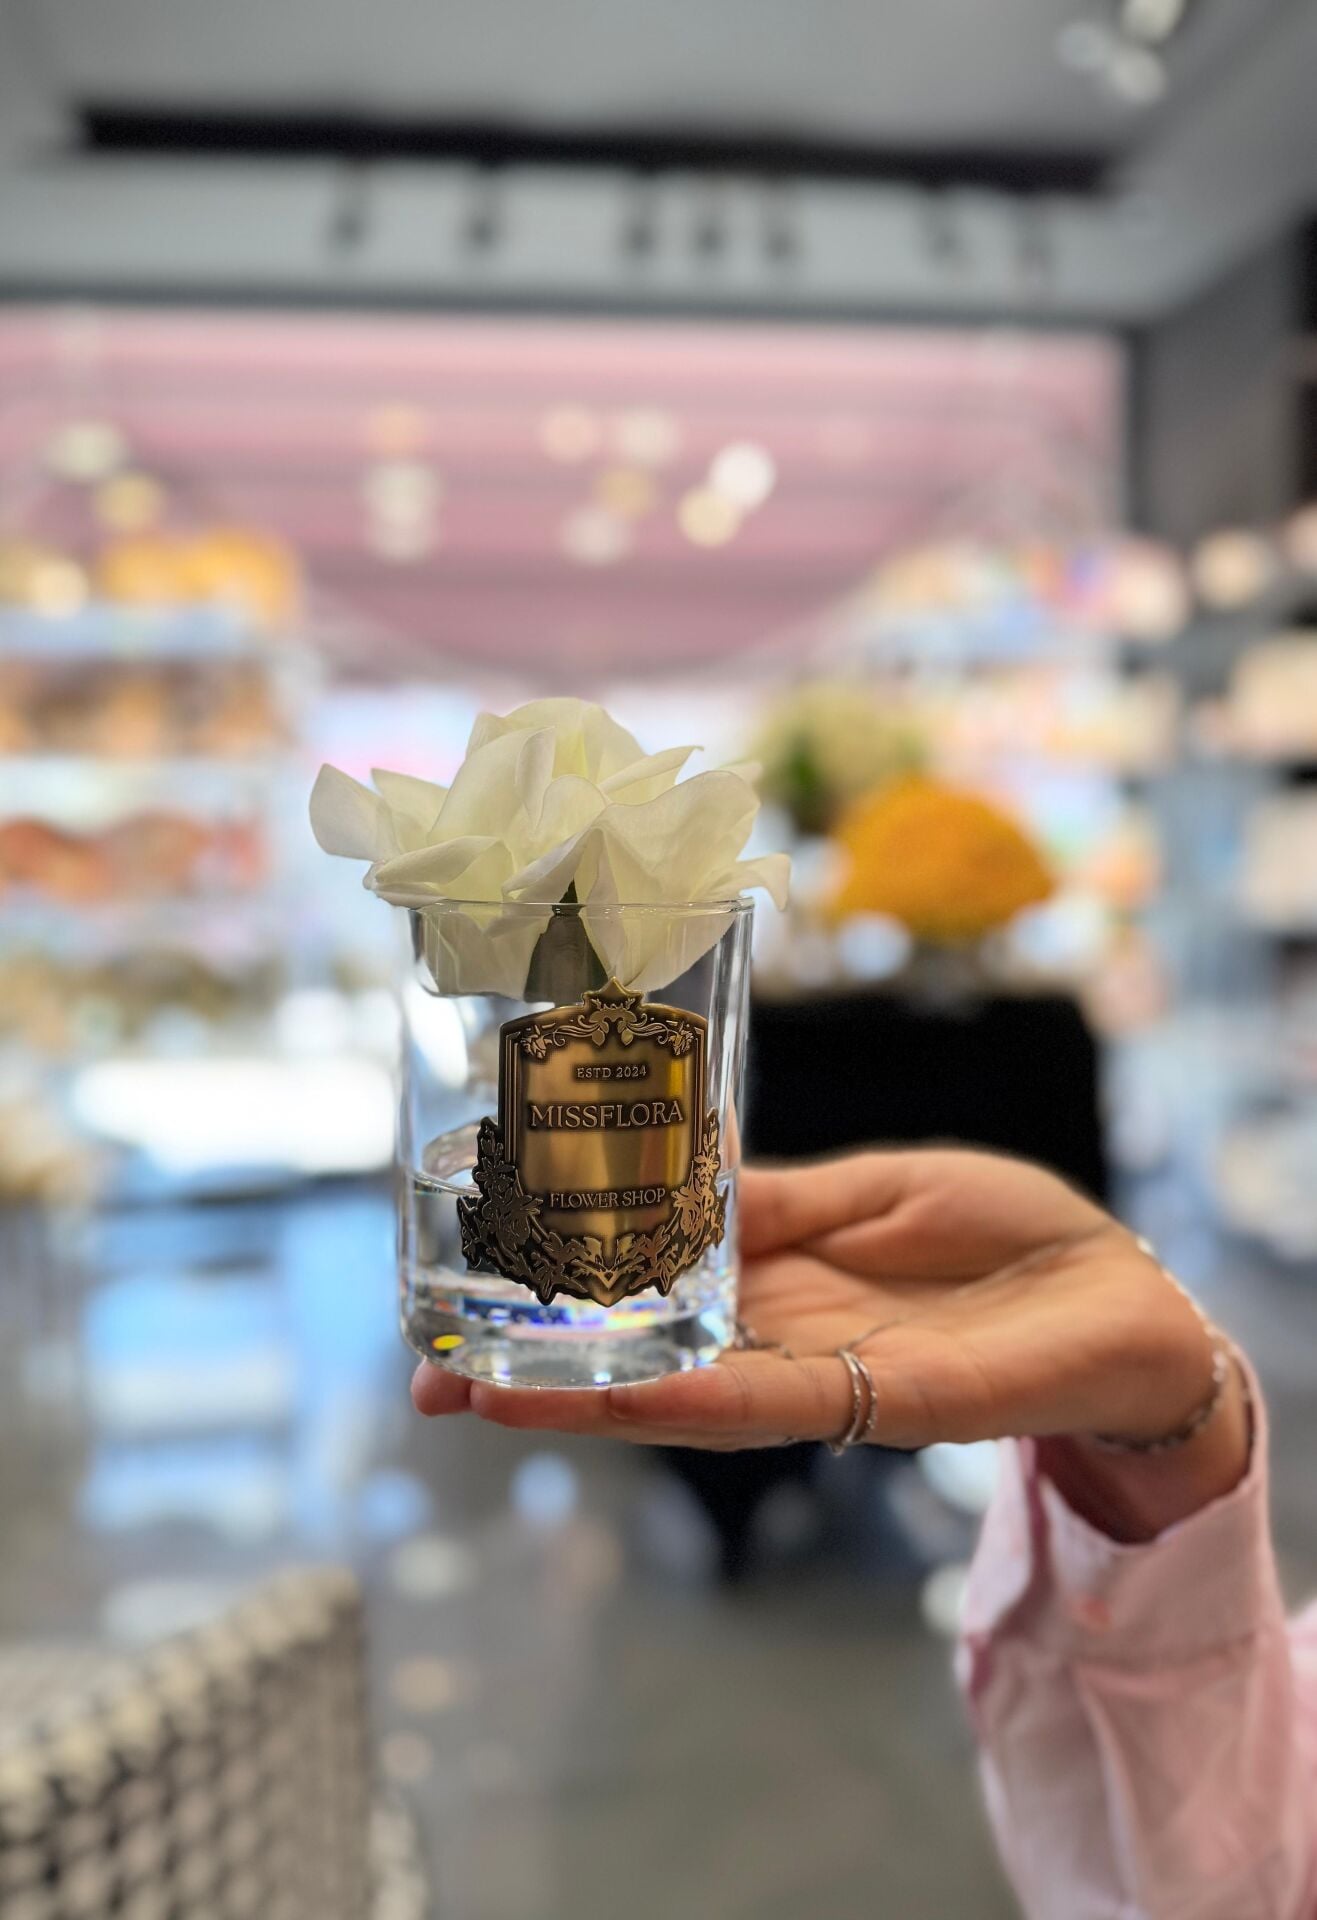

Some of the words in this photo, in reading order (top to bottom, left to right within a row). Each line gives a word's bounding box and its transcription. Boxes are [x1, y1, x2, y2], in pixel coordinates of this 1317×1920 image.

[577, 1067, 611, 1078] ESTD
[616, 1065, 647, 1078] 2024
[530, 1100, 684, 1128] MISSFLORA
[550, 1192, 620, 1208] FLOWER
[622, 1188, 666, 1206] SHOP
